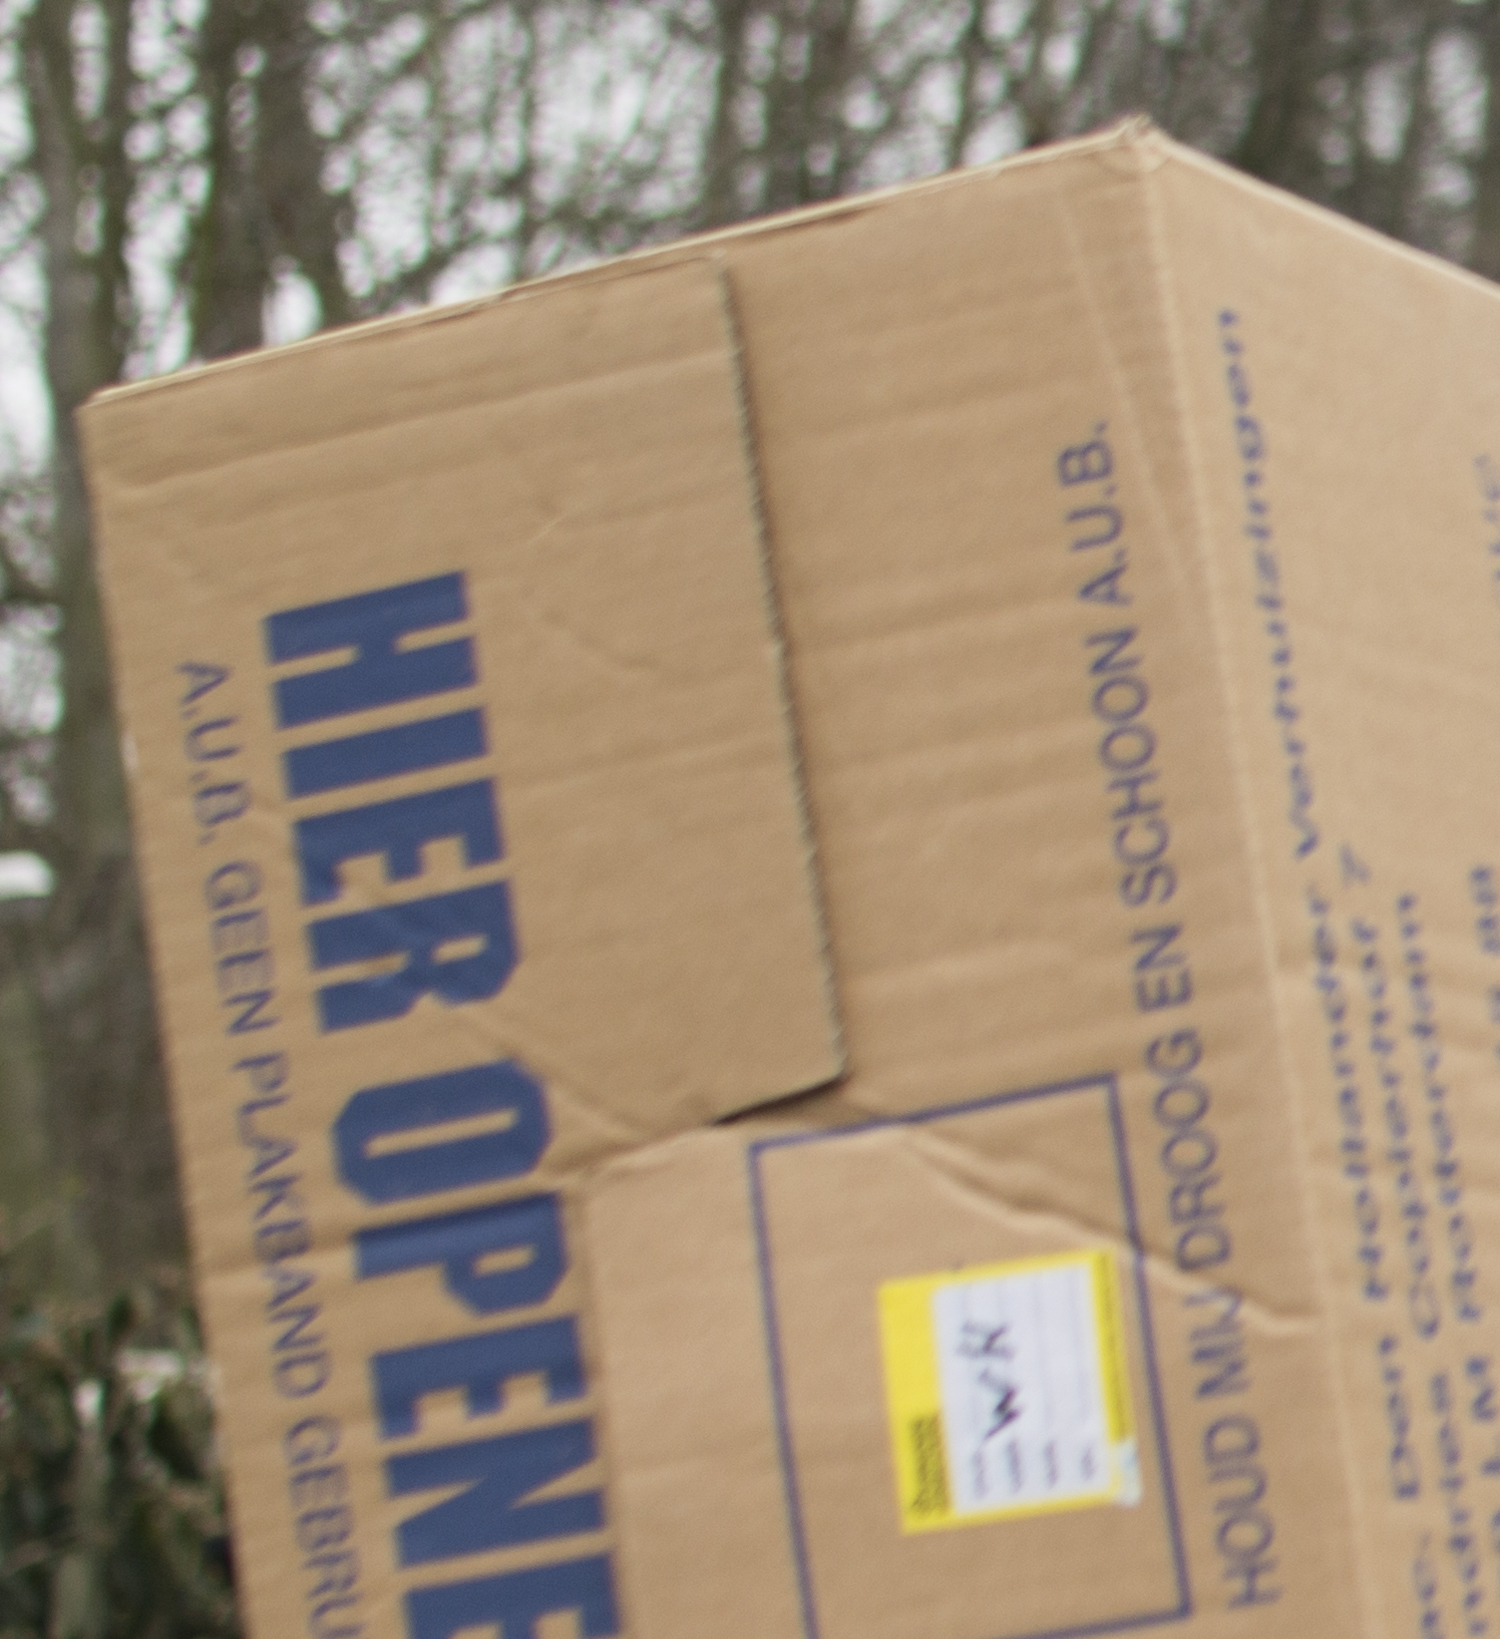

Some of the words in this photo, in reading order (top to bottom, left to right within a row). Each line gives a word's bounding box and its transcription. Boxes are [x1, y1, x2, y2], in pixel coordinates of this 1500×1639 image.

[1056, 419, 1133, 610] A.U.B.
[1216, 307, 1320, 860] Verhuizingen
[178, 659, 250, 846] A.U.B.
[262, 569, 522, 1034] HIER
[1084, 622, 1180, 906] SCHOON
[203, 859, 280, 1040] GEEN
[1130, 922, 1198, 1015] EN
[1145, 1027, 1235, 1273] DROOG
[1304, 885, 1388, 1303] Hollander
[1392, 891, 1483, 1325] Rotterdam
[233, 1049, 332, 1400] PLAKBAND
[1184, 1285, 1253, 1399] MIJ
[1376, 1336, 1422, 1502] Den
[1204, 1415, 1281, 1609] HOUD
